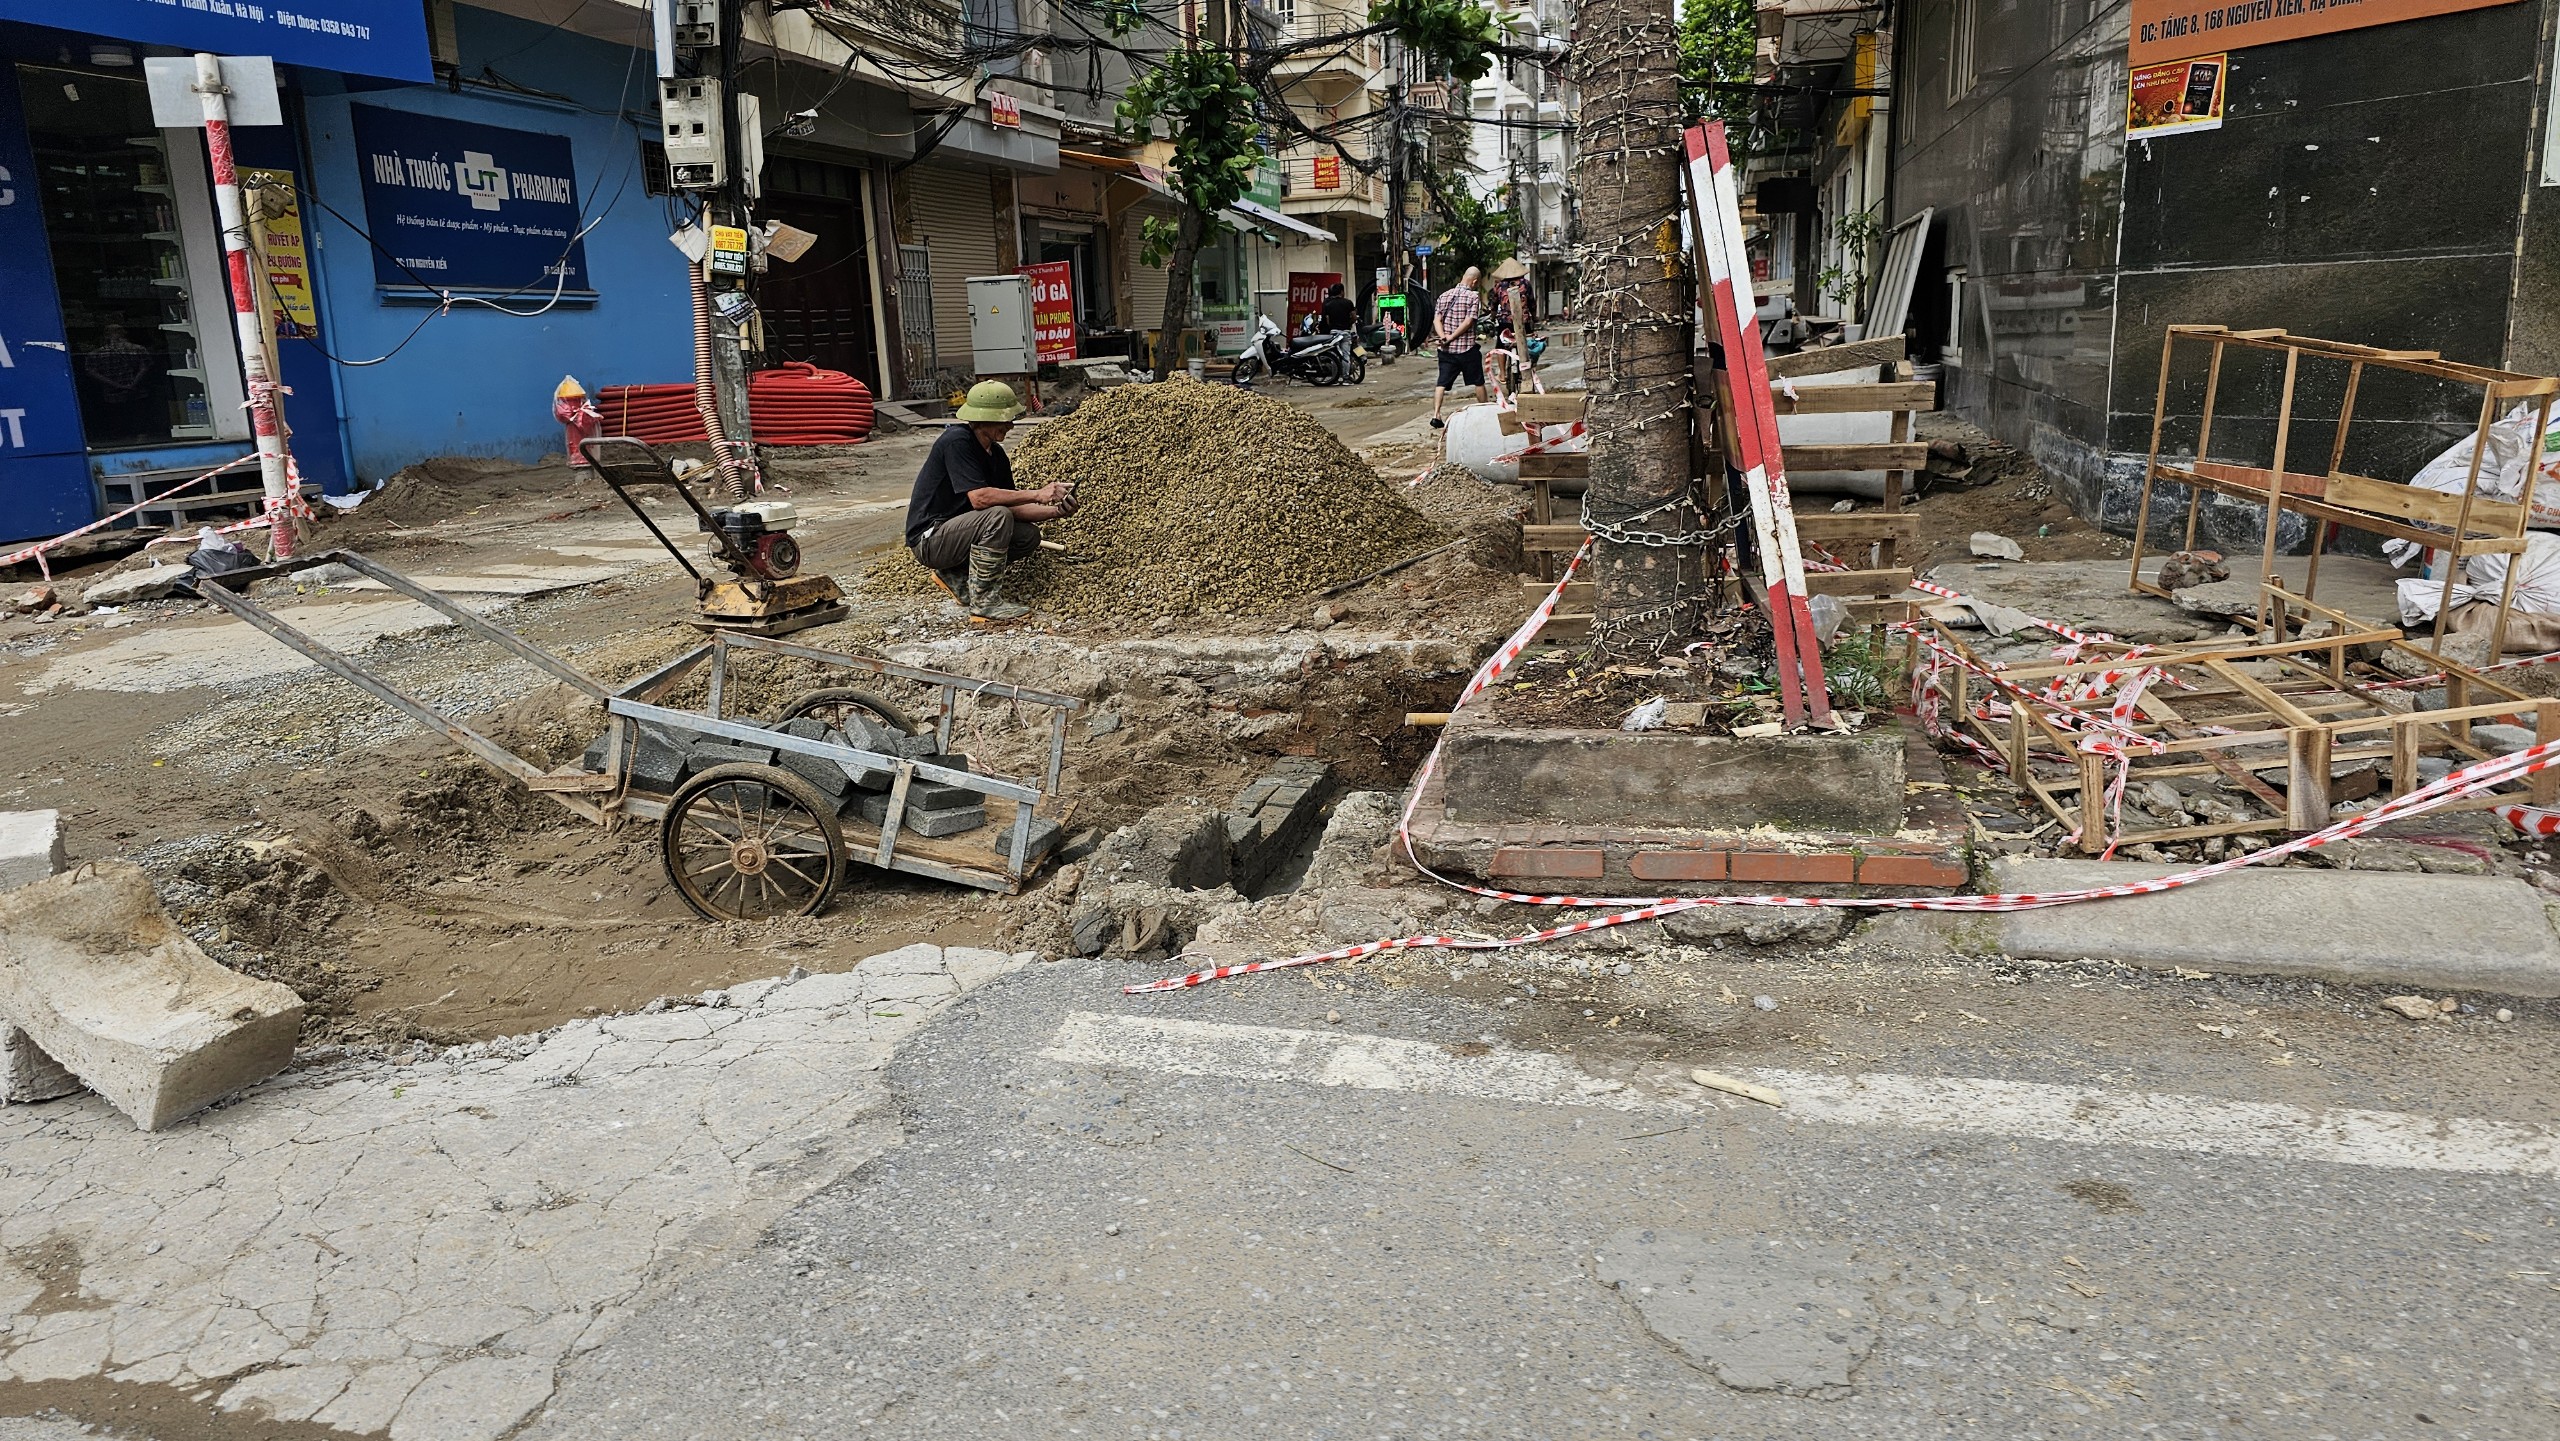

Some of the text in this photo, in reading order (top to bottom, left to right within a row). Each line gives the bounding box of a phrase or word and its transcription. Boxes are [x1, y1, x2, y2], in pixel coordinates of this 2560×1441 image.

[235, 3, 249, 18] Hà
[248, 5, 265, 23] Nội
[320, 19, 341, 35] 0358
[340, 22, 356, 37] 643
[356, 25, 370, 40] 747
[2140, 23, 2158, 44] ĐC:
[2160, 11, 2188, 40] TẦNG
[2190, 13, 2201, 35] 8,
[2203, 9, 2224, 32] 168
[372, 150, 451, 191] NHÀ THUỐC
[464, 167, 499, 192] UT
[512, 172, 571, 204] PHARMACY
[1049, 279, 1069, 302] GÀ
[1292, 281, 1318, 303] PHỞ
[0, 408, 26, 449] T
